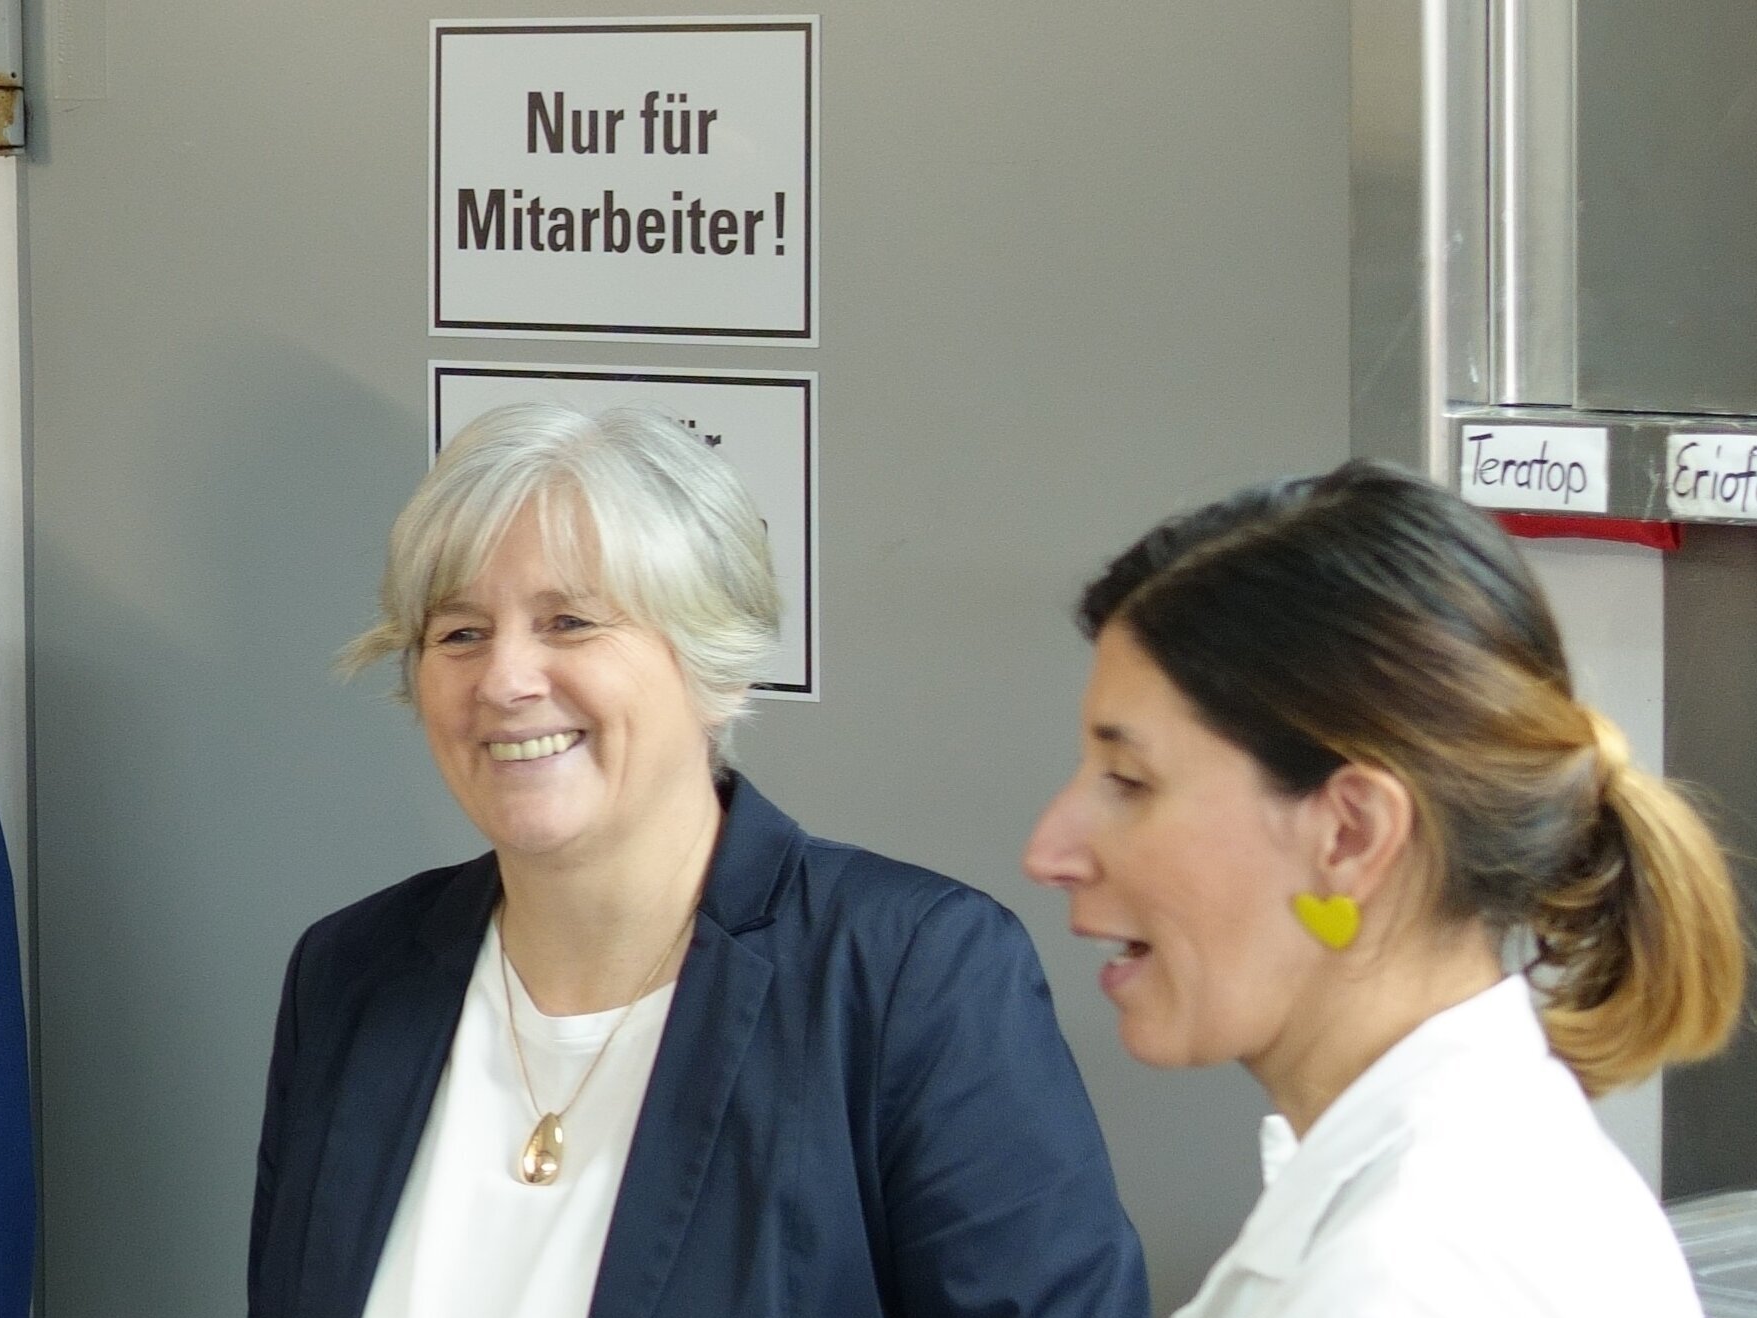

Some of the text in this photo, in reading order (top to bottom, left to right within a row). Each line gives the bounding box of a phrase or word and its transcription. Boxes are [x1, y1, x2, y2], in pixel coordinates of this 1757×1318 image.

[526, 90, 718, 155] Nur für
[457, 188, 786, 257] Mitarbeiter!
[1468, 433, 1587, 504] Teratop
[1673, 442, 1757, 512] Eriof
